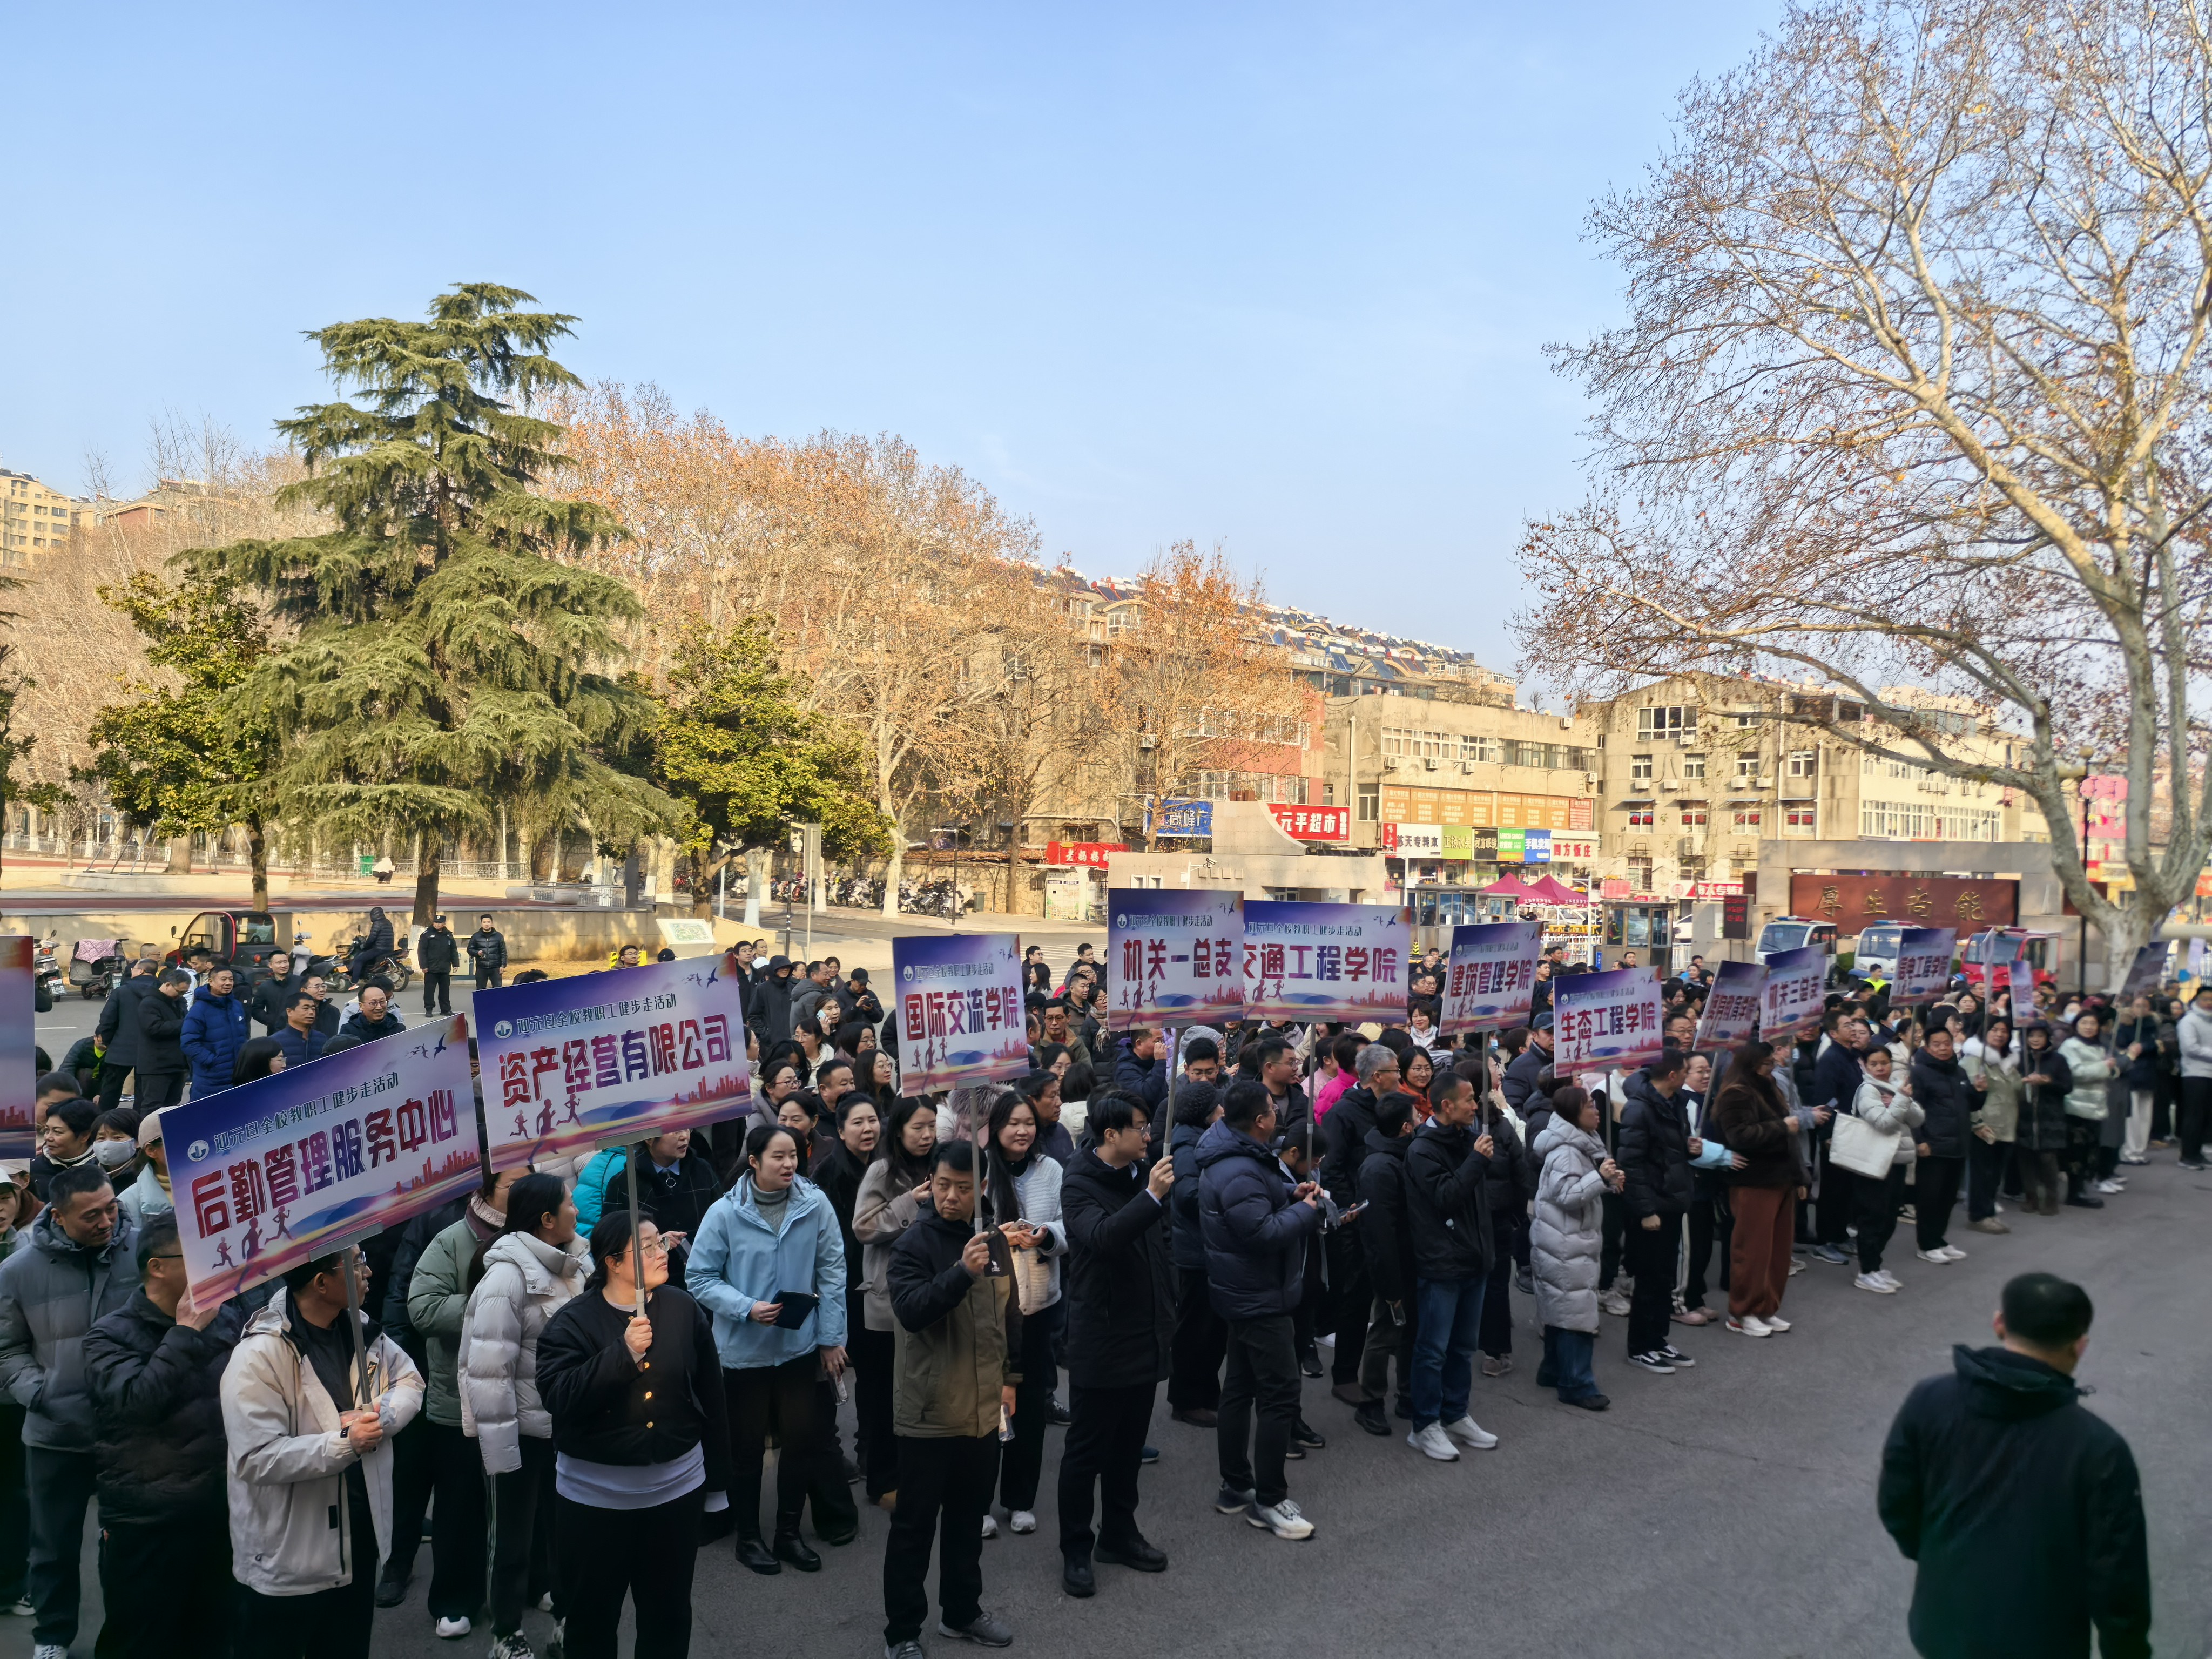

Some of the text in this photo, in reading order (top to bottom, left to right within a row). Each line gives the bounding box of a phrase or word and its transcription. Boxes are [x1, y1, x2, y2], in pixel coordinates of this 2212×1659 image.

[1169, 810, 1213, 827] 尚峰广
[1272, 811, 1336, 834] 元平超市
[1553, 843, 1591, 858] 四方饭庄
[1129, 914, 1212, 928] 迎元旦全校教职工健步走活动
[1812, 885, 1985, 921] 厚生尚能
[1248, 921, 1362, 937] 迎元旦全校教职工健步走活动
[1123, 938, 1232, 982] 机关一总支
[1243, 943, 1398, 983] 交通工程学院
[1450, 959, 1532, 997] 建筑管理学院
[516, 993, 677, 1035] 迎元旦全校教职工健步走活动
[905, 986, 1020, 1041] 国际交流学院
[1561, 1001, 1656, 1042] 生态工程学院
[498, 1014, 732, 1108] 资产经营有限公司
[213, 1071, 399, 1154] 迎元旦全校教职工健步走活动
[191, 1088, 459, 1239] 后勤管理服务中心
